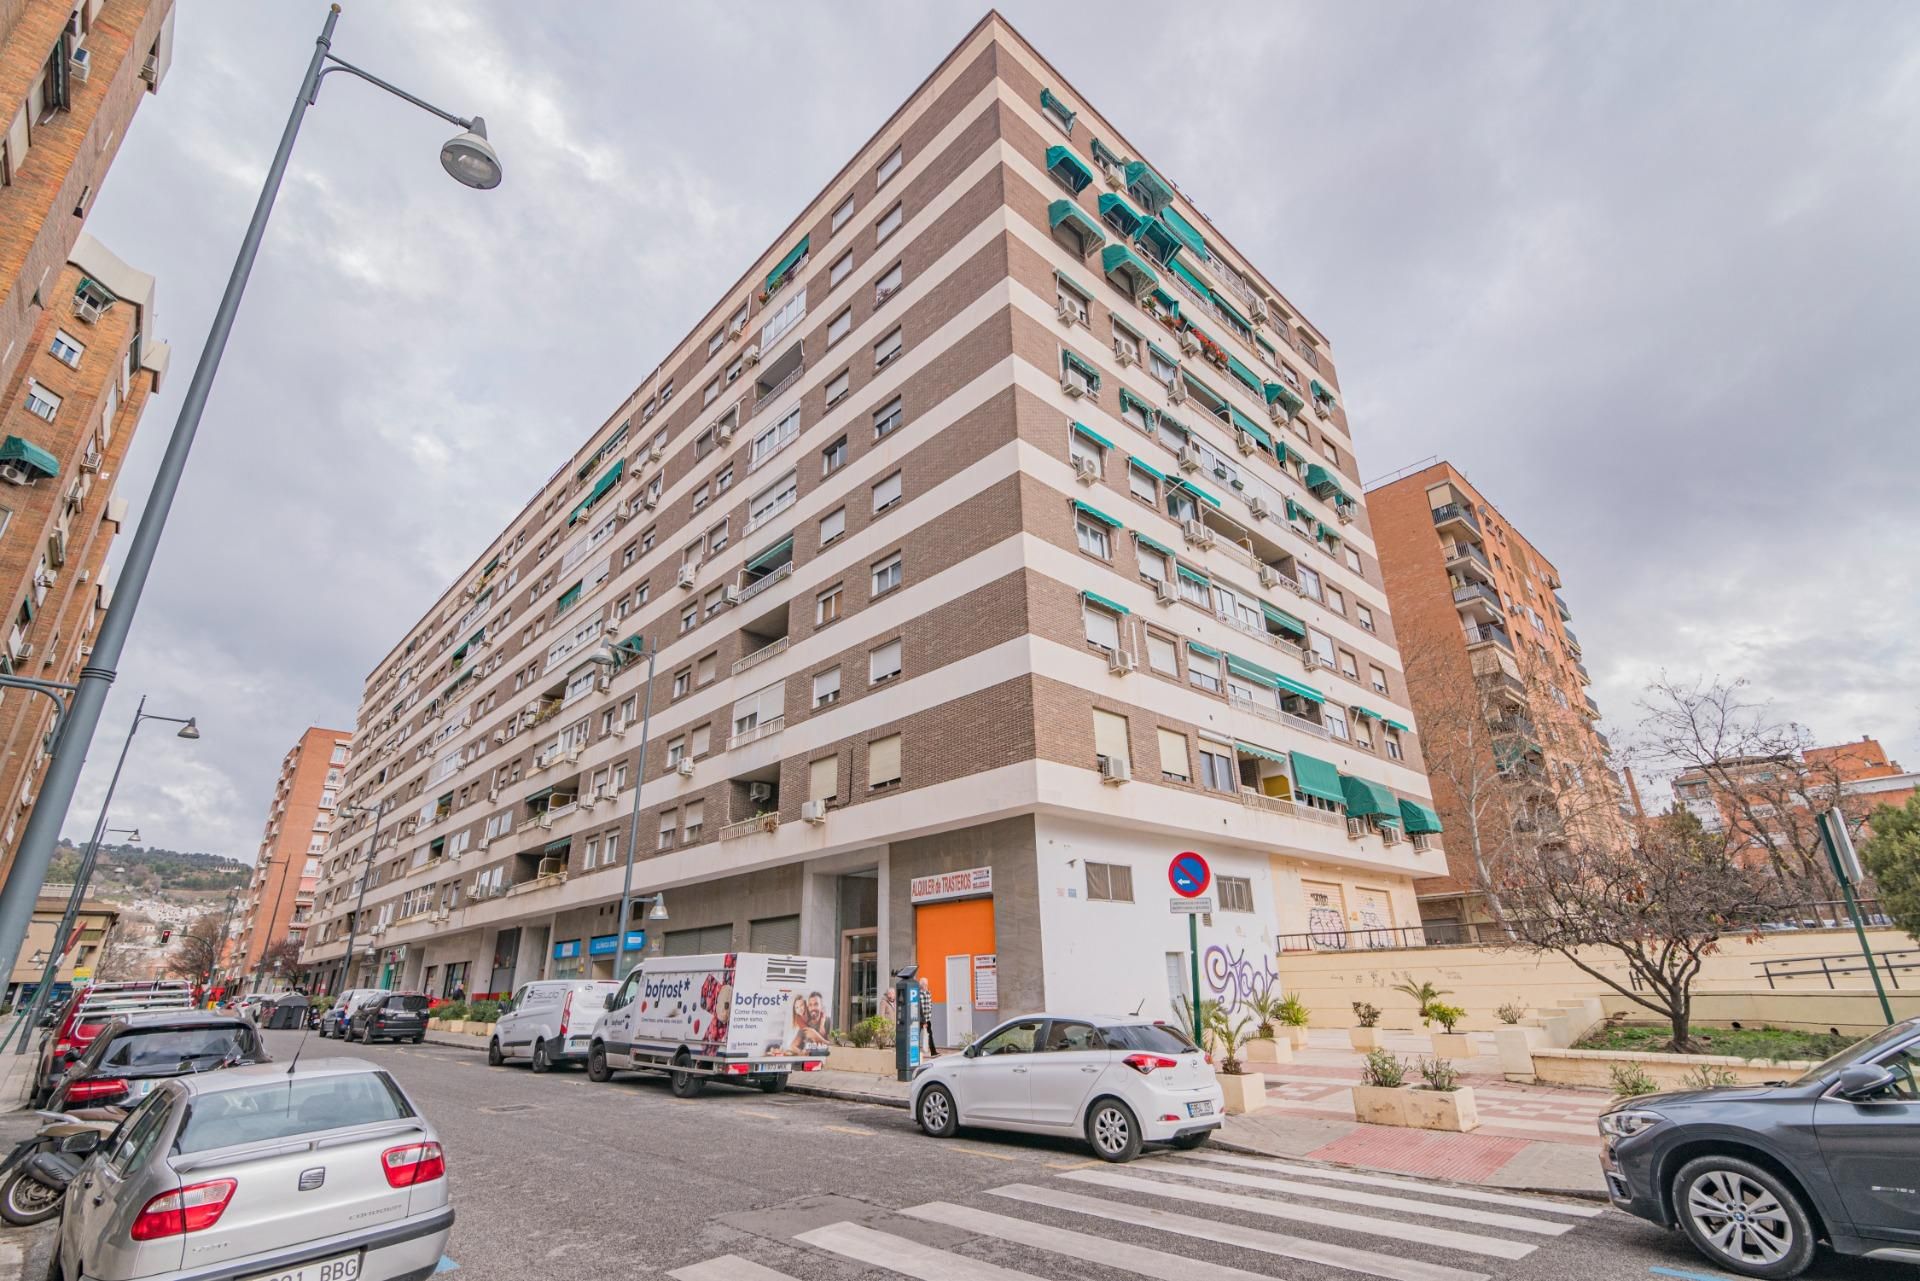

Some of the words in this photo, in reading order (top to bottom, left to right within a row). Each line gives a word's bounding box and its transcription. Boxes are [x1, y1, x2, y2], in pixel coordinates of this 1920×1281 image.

[912, 879, 934, 896] ALQUILER
[942, 873, 972, 893] TRASTEROS
[910, 990, 917, 1001] P
[320, 1259, 357, 1281] BBG
